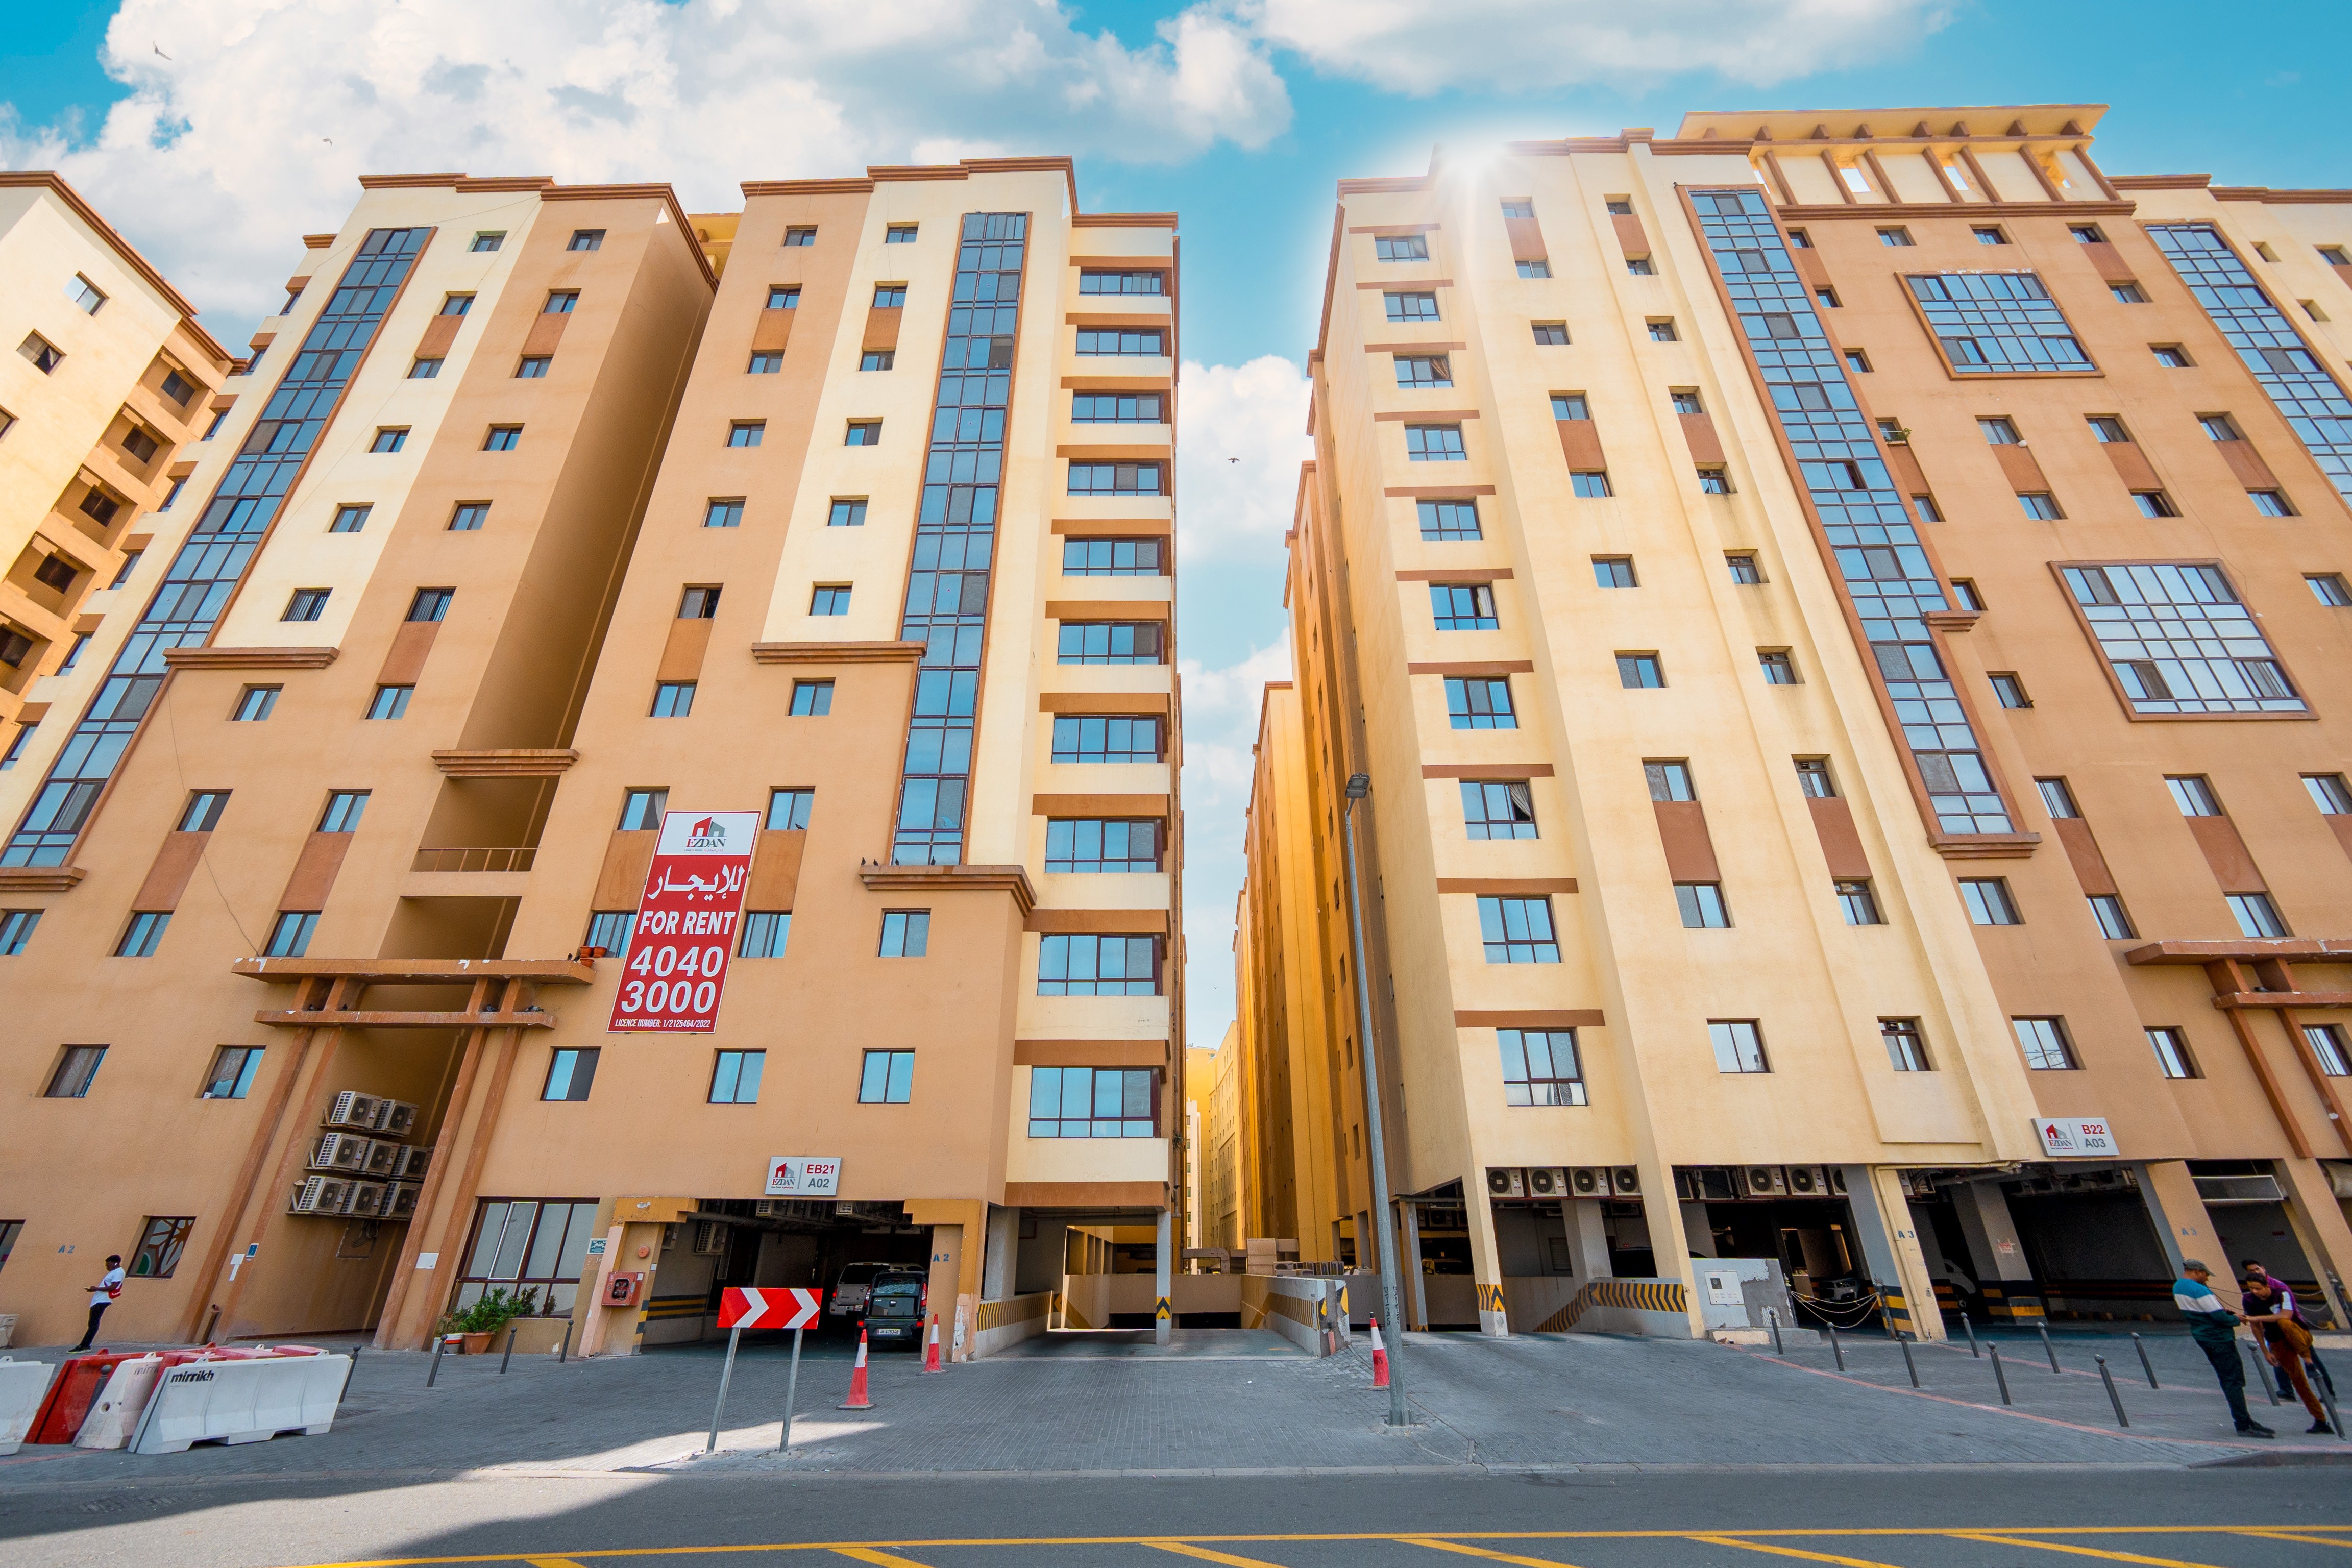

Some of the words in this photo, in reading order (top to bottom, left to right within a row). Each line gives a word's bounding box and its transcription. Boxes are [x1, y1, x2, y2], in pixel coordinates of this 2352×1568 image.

[686, 838, 727, 847] EZDAN
[647, 864, 745, 901] للإيجار
[639, 911, 679, 935] FOR
[682, 911, 736, 935] RENT
[630, 946, 724, 977] 4040
[621, 981, 716, 1013] 3000
[615, 1019, 638, 1027] LICENCE
[637, 1019, 662, 1027] NUMBER:
[2081, 1124, 2106, 1134] B22
[2086, 1138, 2106, 1148] A03
[806, 1164, 834, 1174] EB21
[807, 1178, 829, 1188] A02
[1898, 1230, 1905, 1239] A
[1907, 1230, 1915, 1238] 3
[67, 1245, 75, 1254] 2
[933, 1254, 940, 1262] A
[943, 1253, 949, 1262] 2
[170, 1370, 215, 1383] mirrikh
